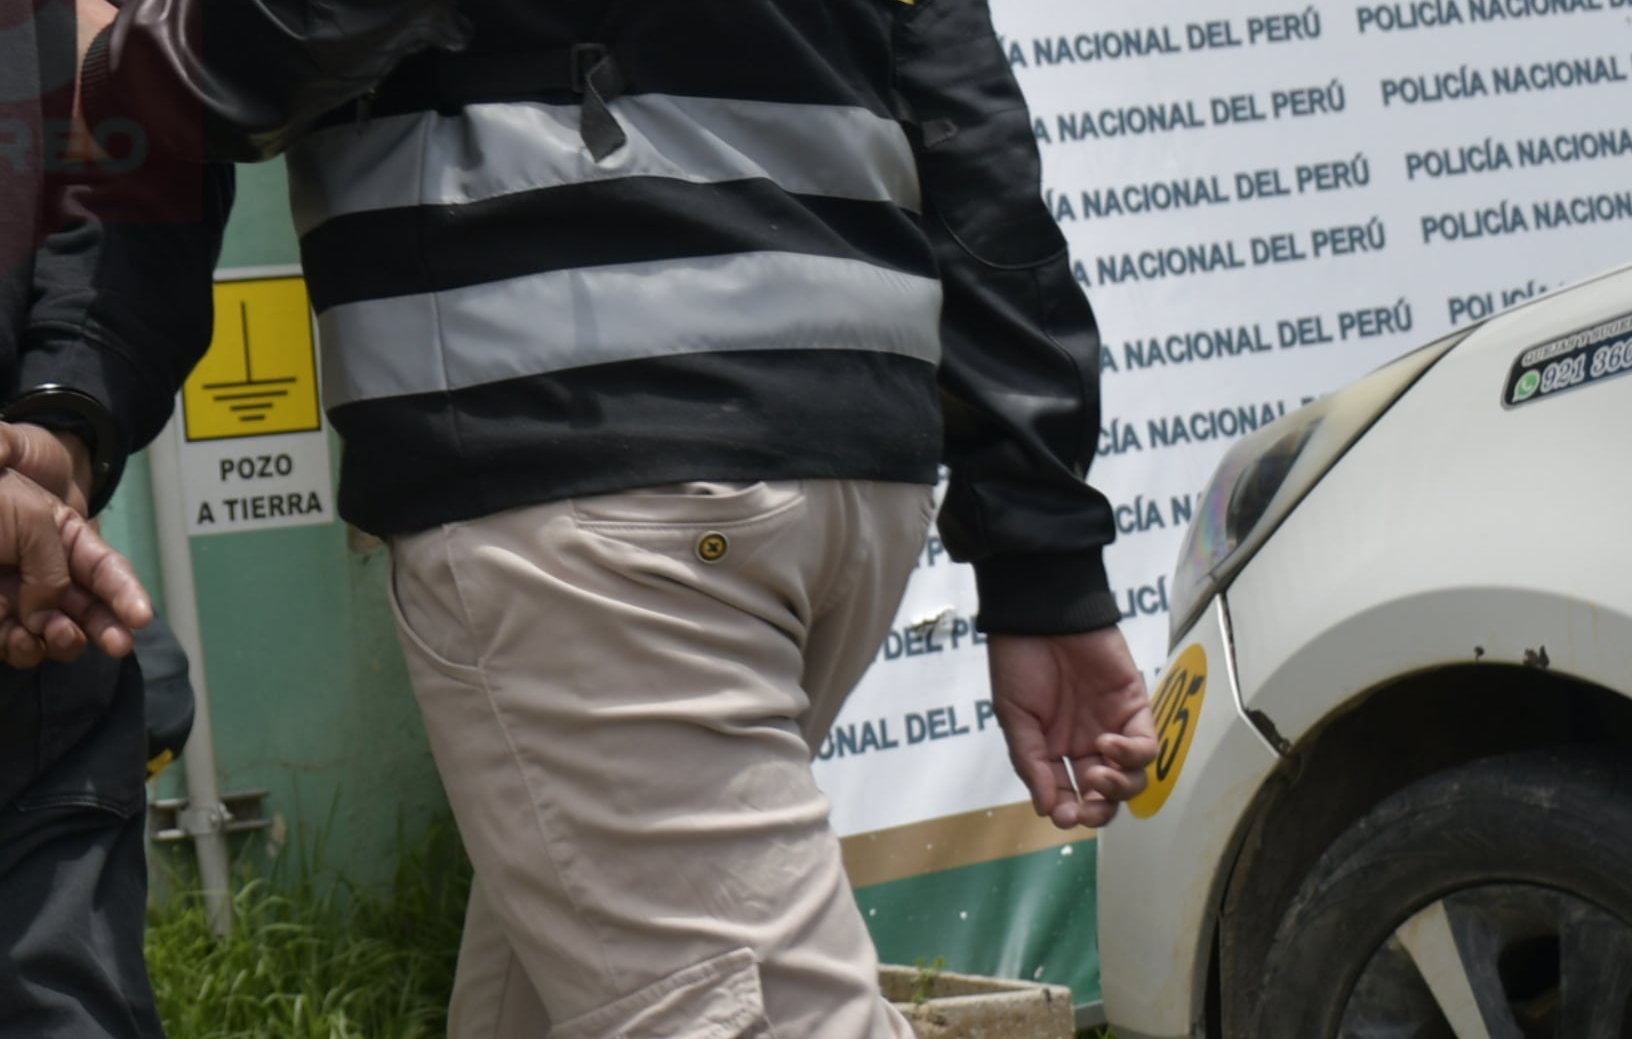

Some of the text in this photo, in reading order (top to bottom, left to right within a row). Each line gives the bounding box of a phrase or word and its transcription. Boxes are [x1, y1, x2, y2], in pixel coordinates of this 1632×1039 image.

[1033, 27, 1180, 66] NACIONAL
[1187, 21, 1241, 50] DEL
[1247, 5, 1321, 44] PERÚ
[1381, 55, 1627, 106] POLICÍA NACIONAL
[1058, 100, 1205, 141] NACIONAL
[1211, 94, 1266, 125] DEL
[1272, 79, 1345, 118] PERÚ
[1405, 127, 1632, 180] POLICÍA NACIONA
[1082, 176, 1230, 219] NACIONAL
[1235, 168, 1290, 200] DEL
[1296, 153, 1369, 193] PERÚ
[1421, 191, 1632, 243] POLICÍA NACION
[1097, 241, 1245, 285] NACIONAL
[1250, 234, 1306, 265] DEL
[1311, 217, 1385, 257] PERÚ
[1124, 324, 1271, 370] NACIONAL
[1277, 316, 1333, 348] DEL
[1338, 298, 1412, 340] PERÚ
[1540, 352, 1587, 393] 921
[220, 453, 294, 481] POZO
[197, 492, 324, 524] A TIERRA
[906, 707, 970, 745] DEL
